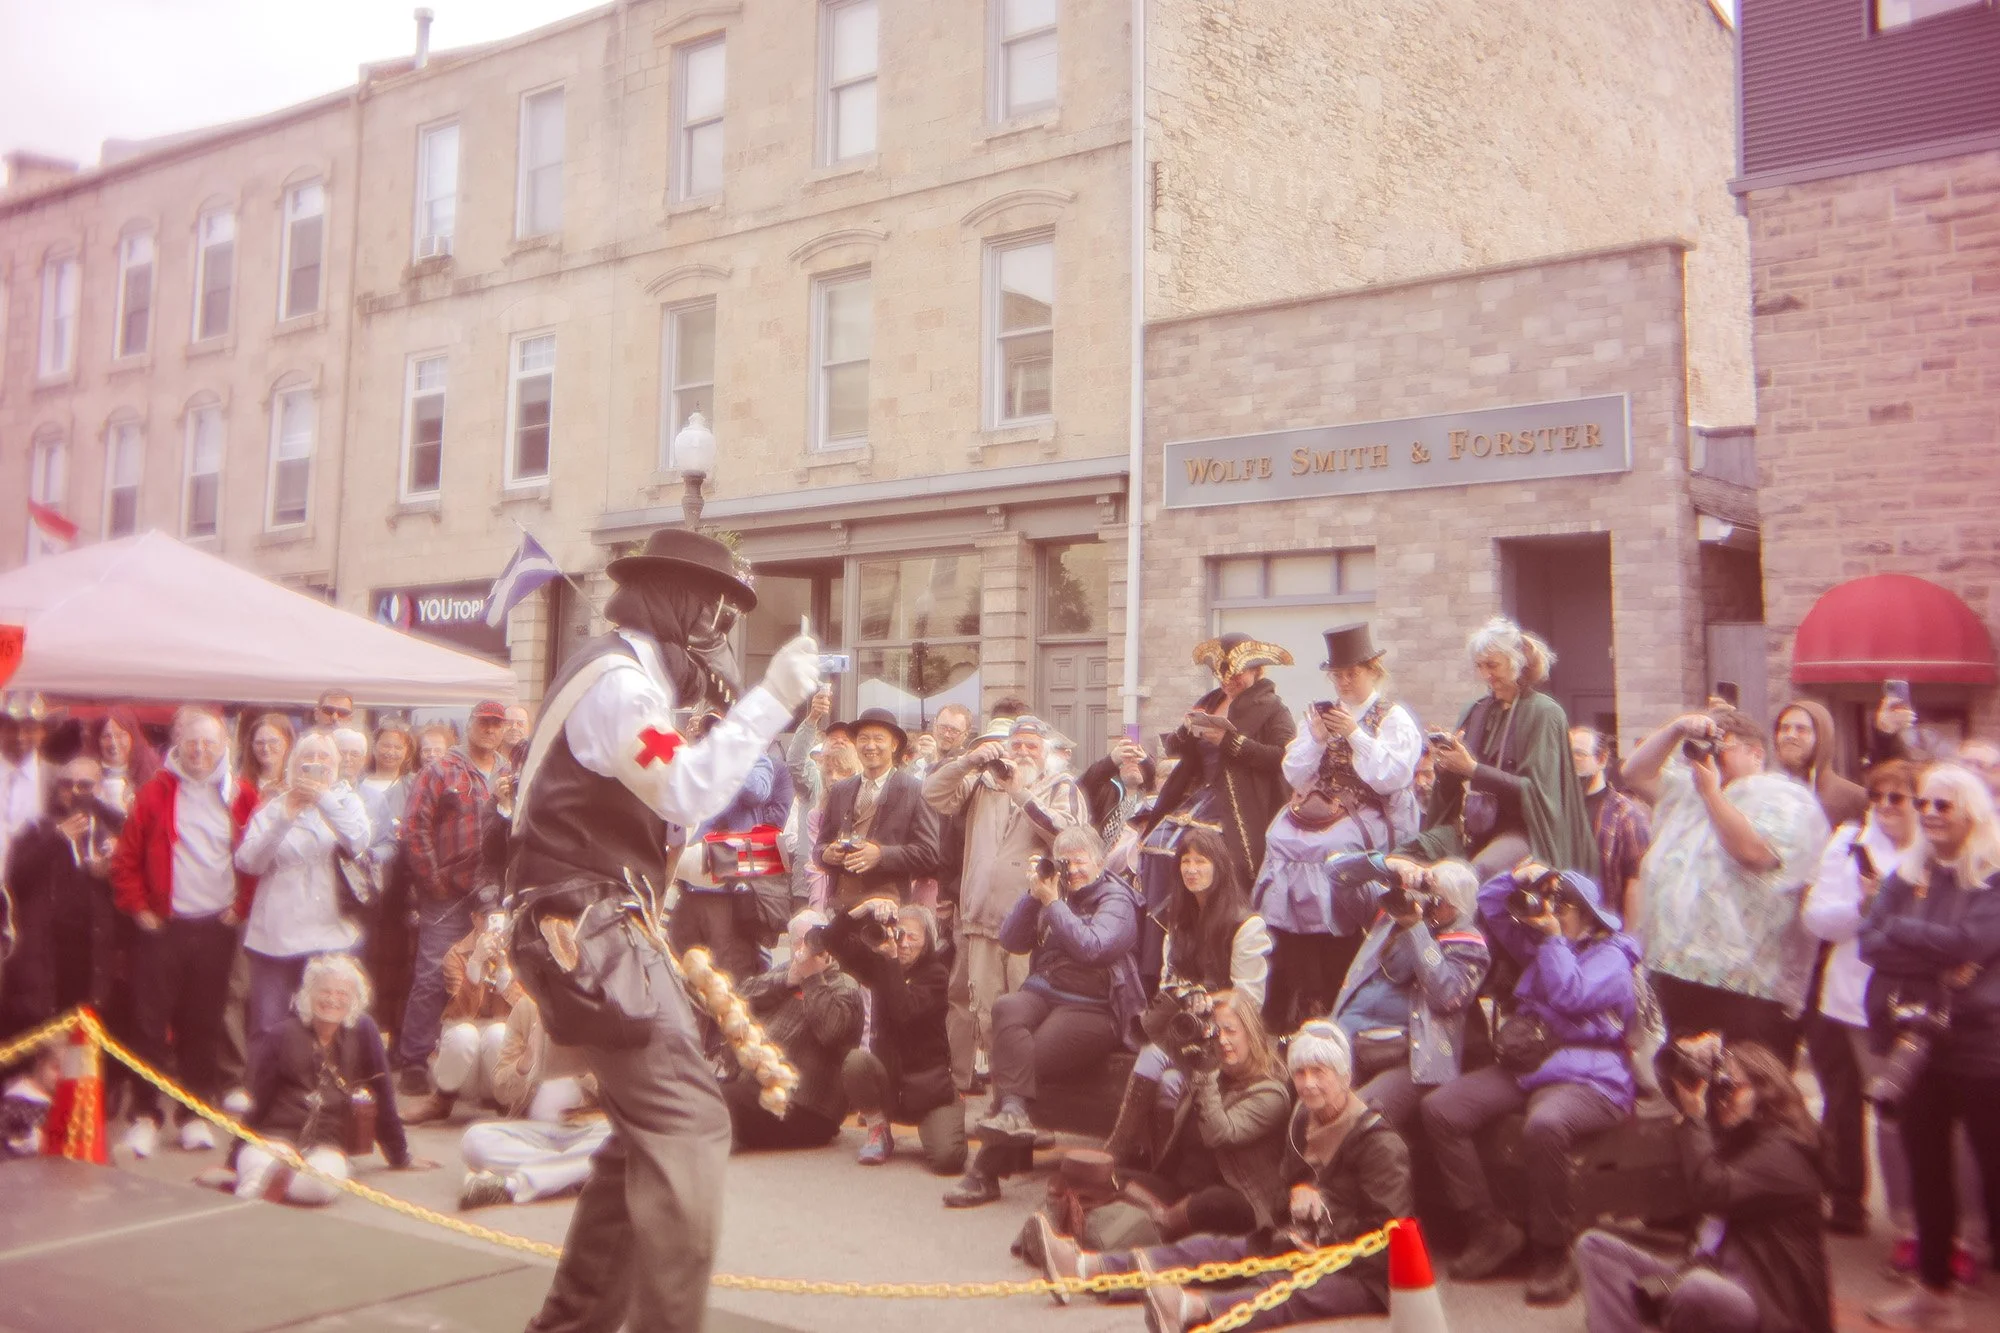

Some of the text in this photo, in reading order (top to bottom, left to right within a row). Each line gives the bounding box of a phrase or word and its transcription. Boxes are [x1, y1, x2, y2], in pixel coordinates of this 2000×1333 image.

[1184, 423, 1603, 484] WOLFE SMITH & FORSTER
